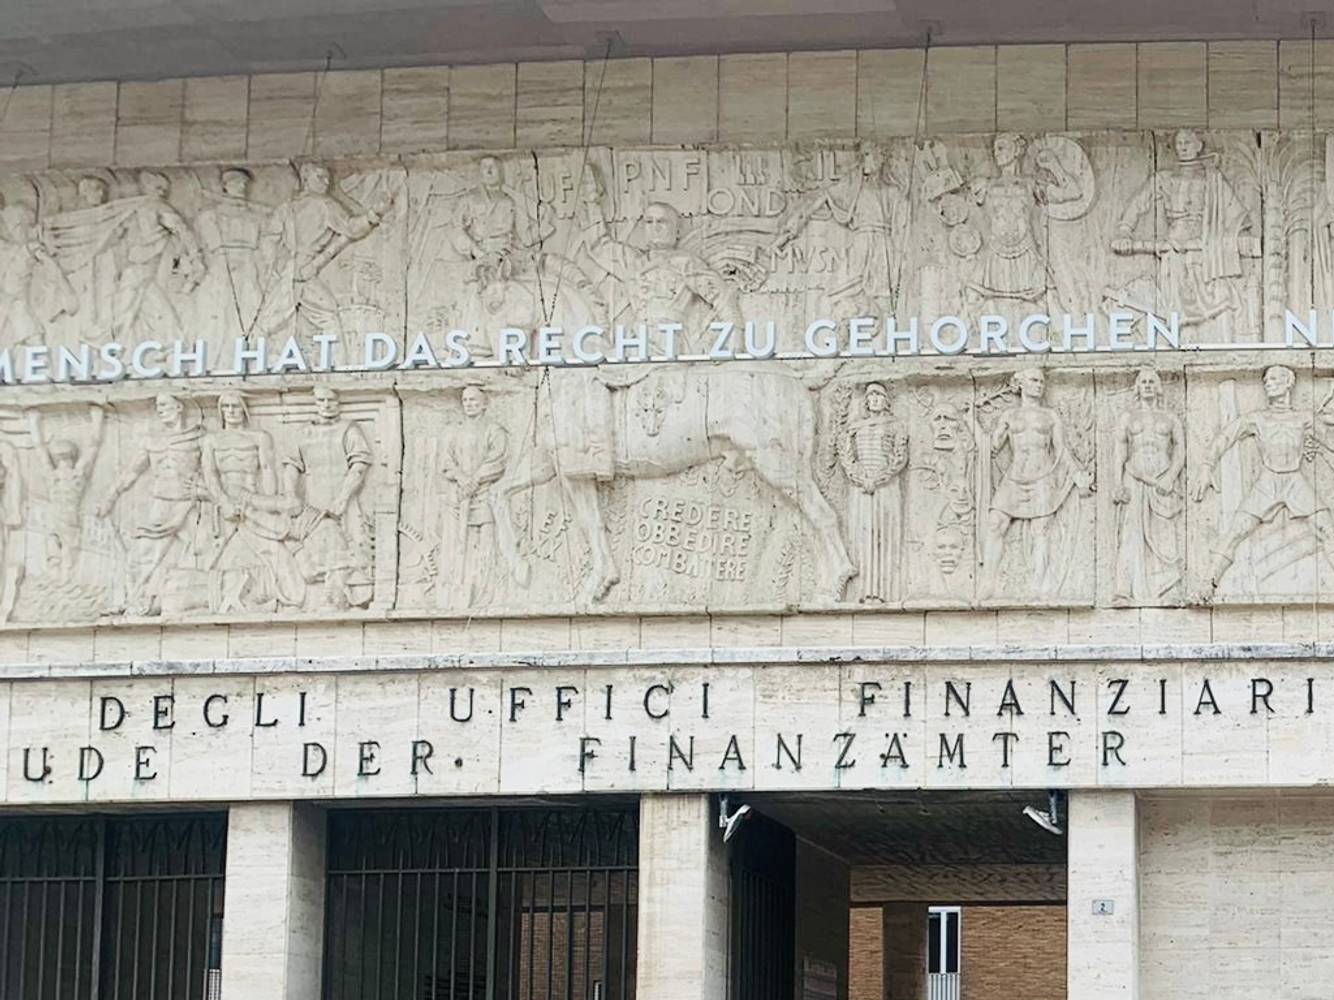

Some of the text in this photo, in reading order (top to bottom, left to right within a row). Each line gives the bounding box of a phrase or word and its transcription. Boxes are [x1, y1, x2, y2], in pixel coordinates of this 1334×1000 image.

[624, 157, 701, 194] PNF
[707, 187, 788, 218] OND
[234, 334, 337, 374] HAT
[364, 329, 473, 370] DAS
[499, 322, 683, 364] RECHT
[709, 320, 776, 358] ZU
[805, 312, 1181, 357] GEHORCHEN
[641, 498, 752, 532] CREDERE
[637, 522, 752, 557] OBBEDIRE
[100, 678, 1315, 731] DEGLI UFFICI FINANZIARI
[23, 731, 1128, 782] UDE DER FINANZÄMTER
